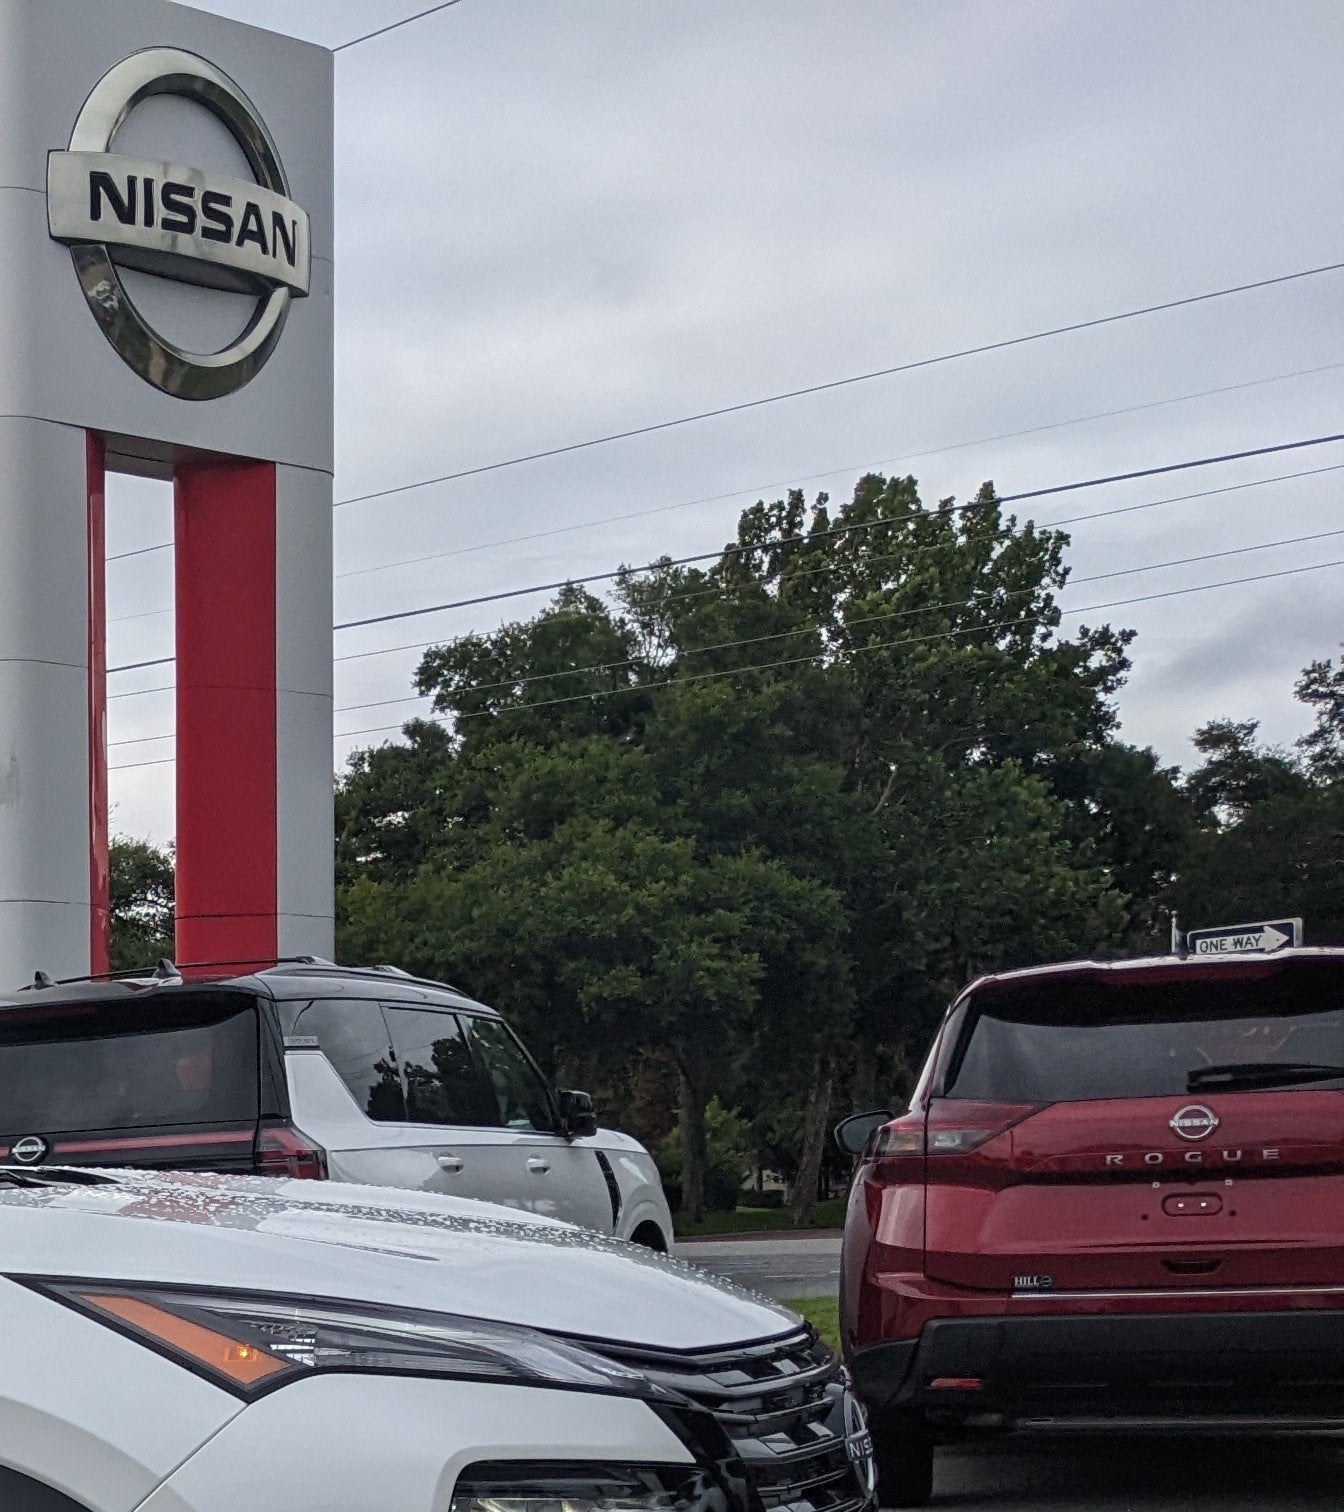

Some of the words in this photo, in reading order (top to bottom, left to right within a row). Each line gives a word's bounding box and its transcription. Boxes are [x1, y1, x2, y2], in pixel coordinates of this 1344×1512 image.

[89, 171, 297, 268] NISSAN
[1199, 939, 1229, 953] ONE
[1232, 935, 1262, 949] WAY
[1170, 1117, 1220, 1127] NISSAN
[1105, 1149, 1280, 1166] ROGUE
